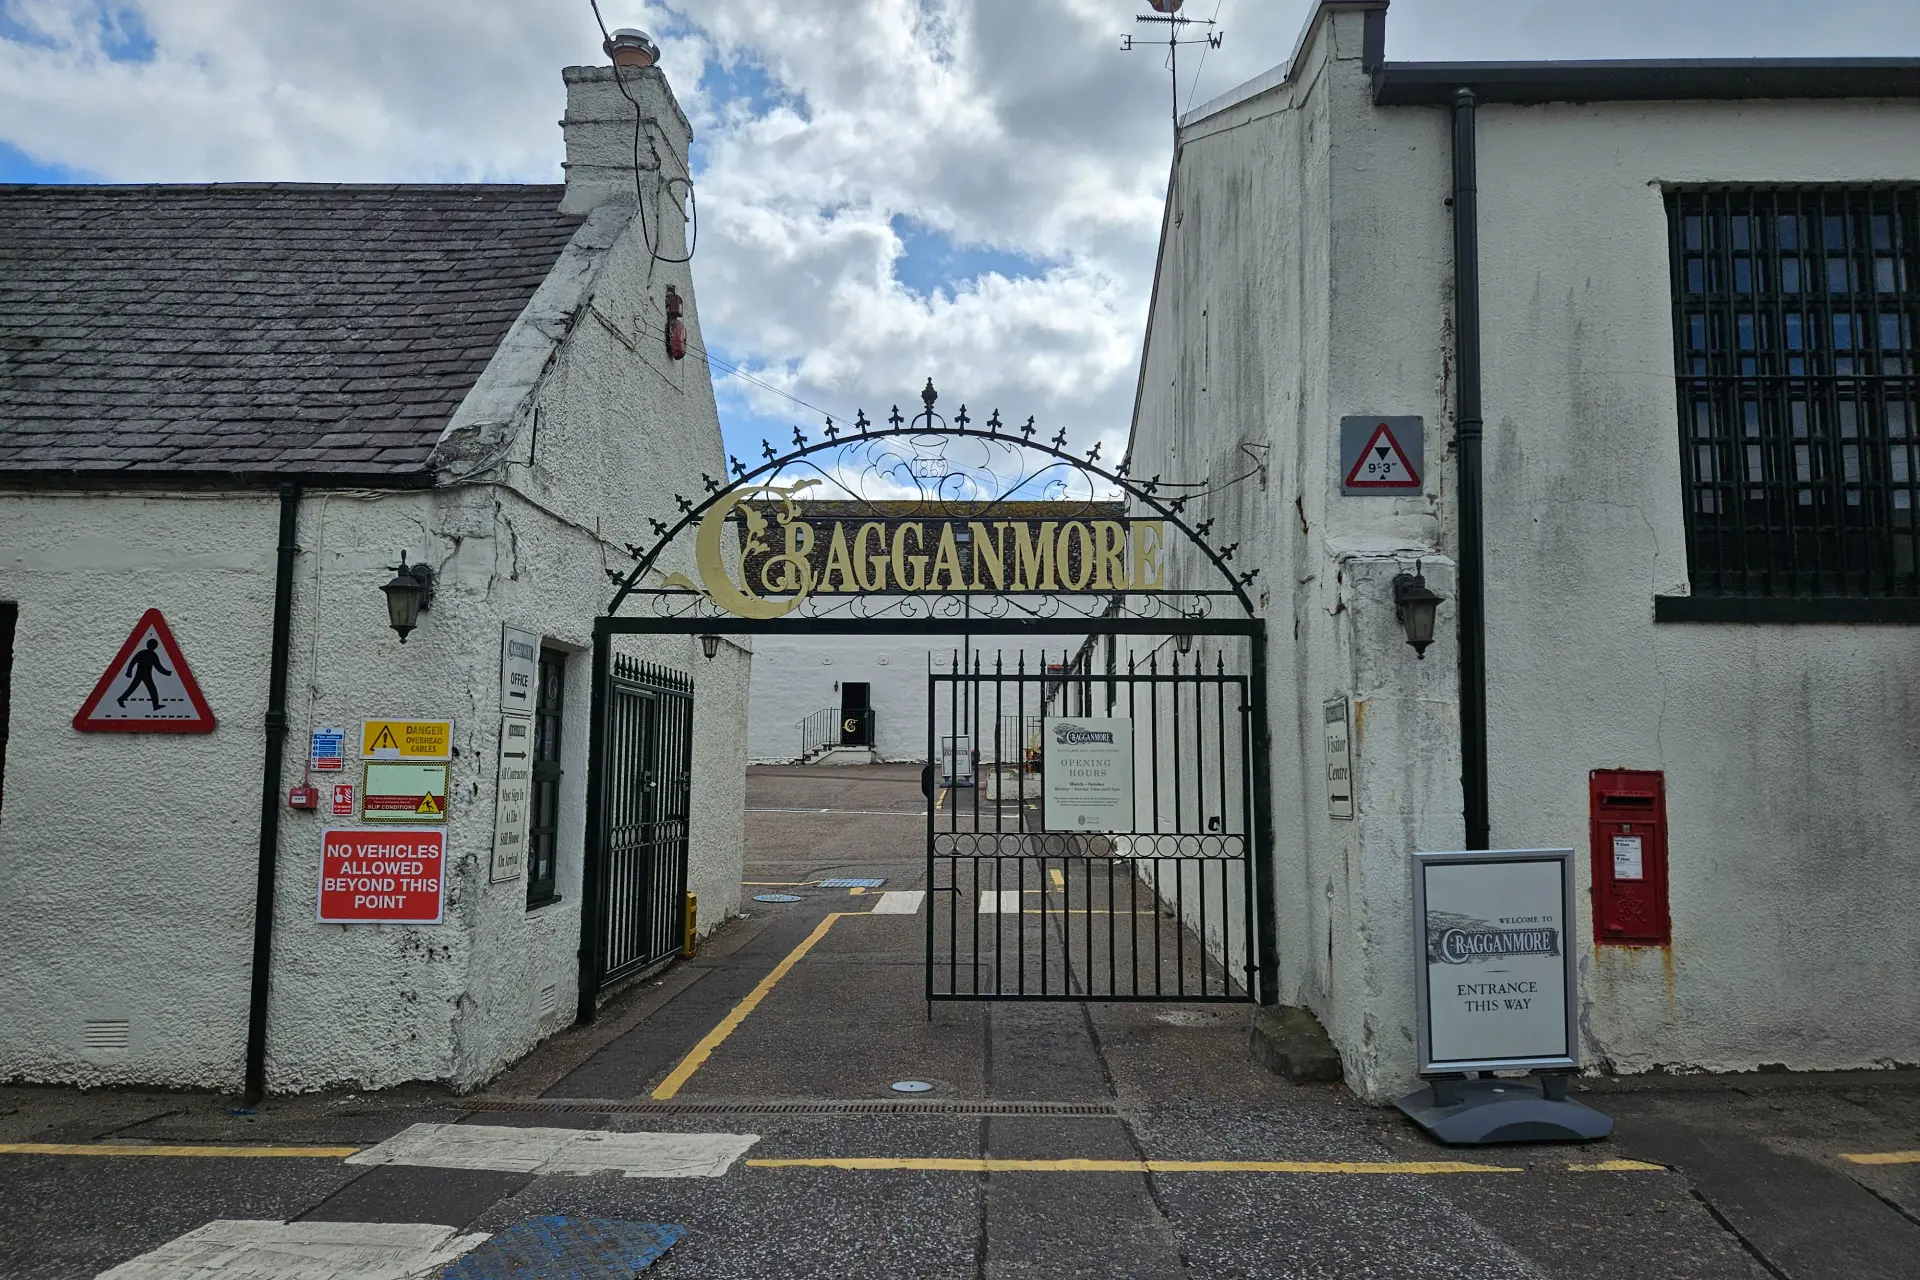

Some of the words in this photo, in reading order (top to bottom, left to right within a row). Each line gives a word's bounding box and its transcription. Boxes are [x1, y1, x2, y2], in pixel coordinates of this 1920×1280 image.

[663, 479, 1165, 619] CRAGGANMORE
[510, 672, 528, 687] OFFICE
[406, 726, 444, 735] DANGER
[1327, 735, 1346, 753] Visitor
[1328, 763, 1348, 780] Centre
[327, 844, 352, 858] NO
[357, 844, 439, 859] VEHICLES
[340, 861, 423, 875] ALLOWED
[324, 878, 395, 892] BEYOND
[400, 878, 438, 892] THIS
[354, 895, 406, 909] POINT
[1498, 916, 1539, 924] WELCOME
[1440, 928, 1551, 964] CRAGGANMORE
[1457, 982, 1538, 996] ENTRANCE
[1464, 1000, 1499, 1012] THIS
[1504, 998, 1531, 1010] WAY
